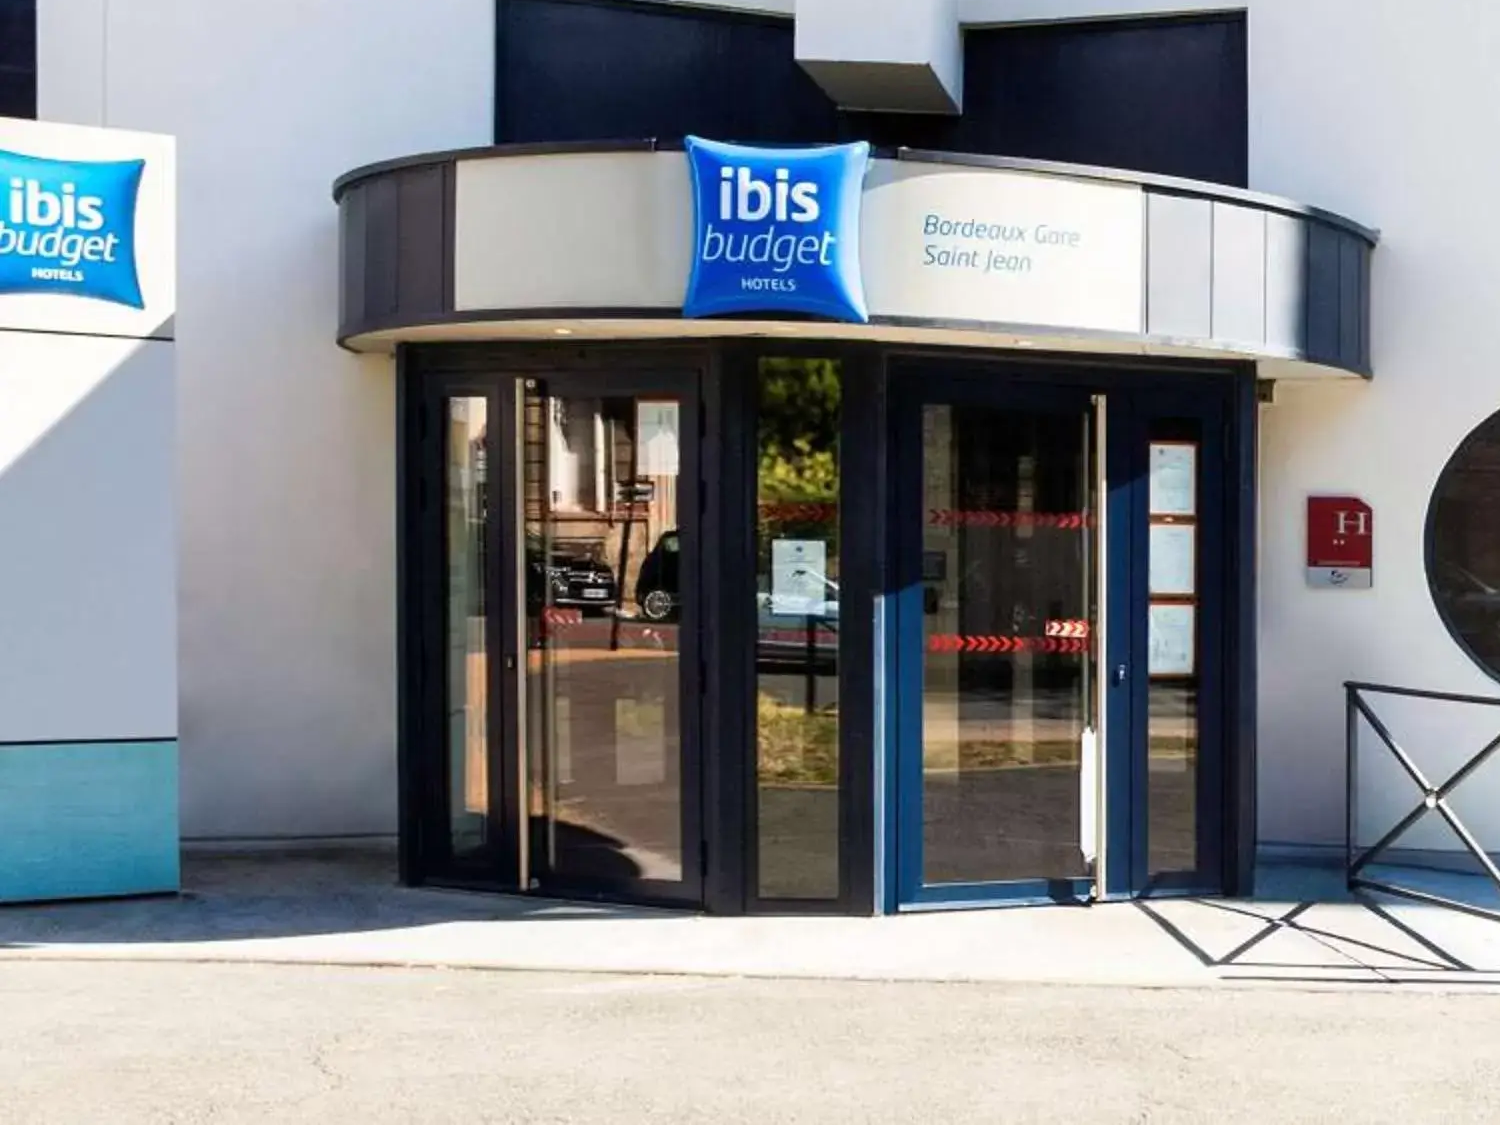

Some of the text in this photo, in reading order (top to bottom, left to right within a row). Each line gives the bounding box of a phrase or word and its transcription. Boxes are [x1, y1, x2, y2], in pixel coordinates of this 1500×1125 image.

[9, 176, 105, 231] ibis
[720, 166, 820, 222] ibis
[923, 214, 1081, 247] Bordeaux Gare
[702, 224, 836, 272] budget
[923, 244, 1032, 273] Saint Jean
[31, 267, 84, 282] HOTELS
[741, 277, 796, 291] HOTELS
[1334, 511, 1368, 535] H
